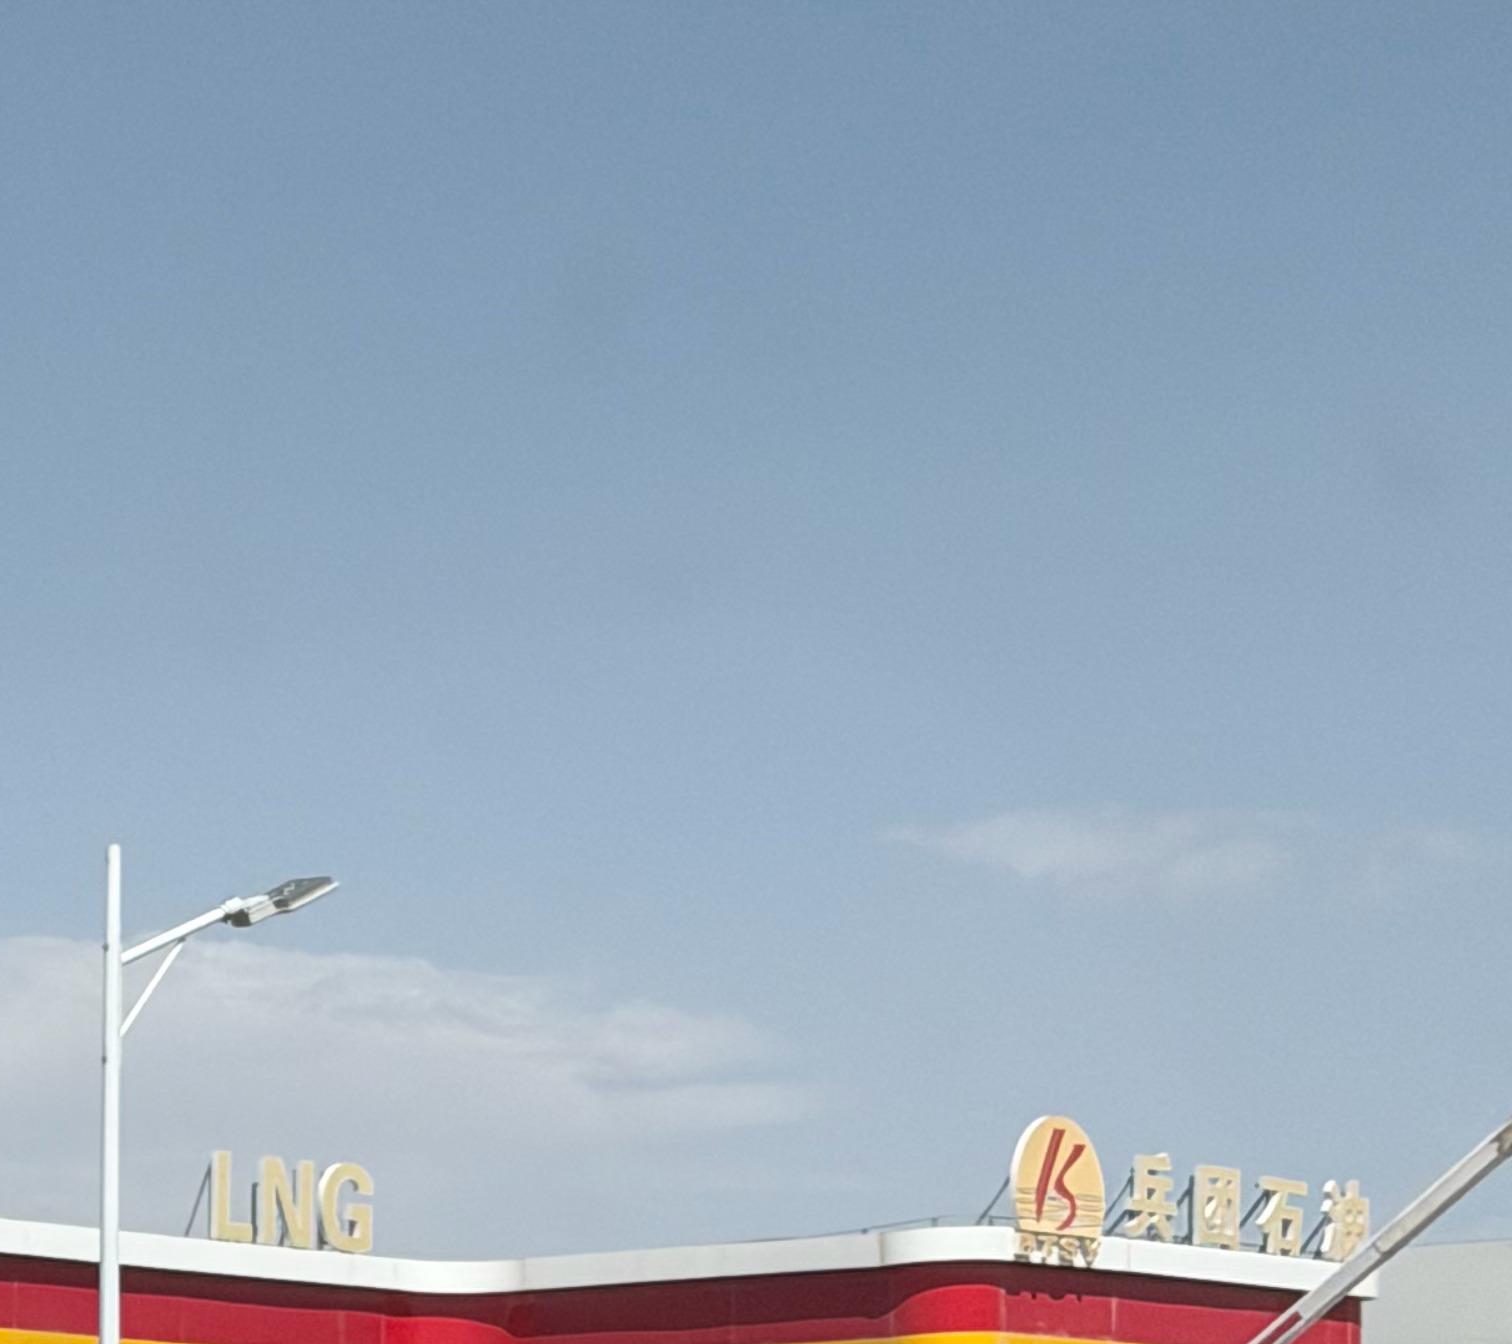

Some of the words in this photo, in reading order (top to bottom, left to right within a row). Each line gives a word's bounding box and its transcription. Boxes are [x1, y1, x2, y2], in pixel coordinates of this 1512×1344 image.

[211, 1150, 374, 1253] LNG
[1124, 1152, 1370, 1261] 兵团石油
